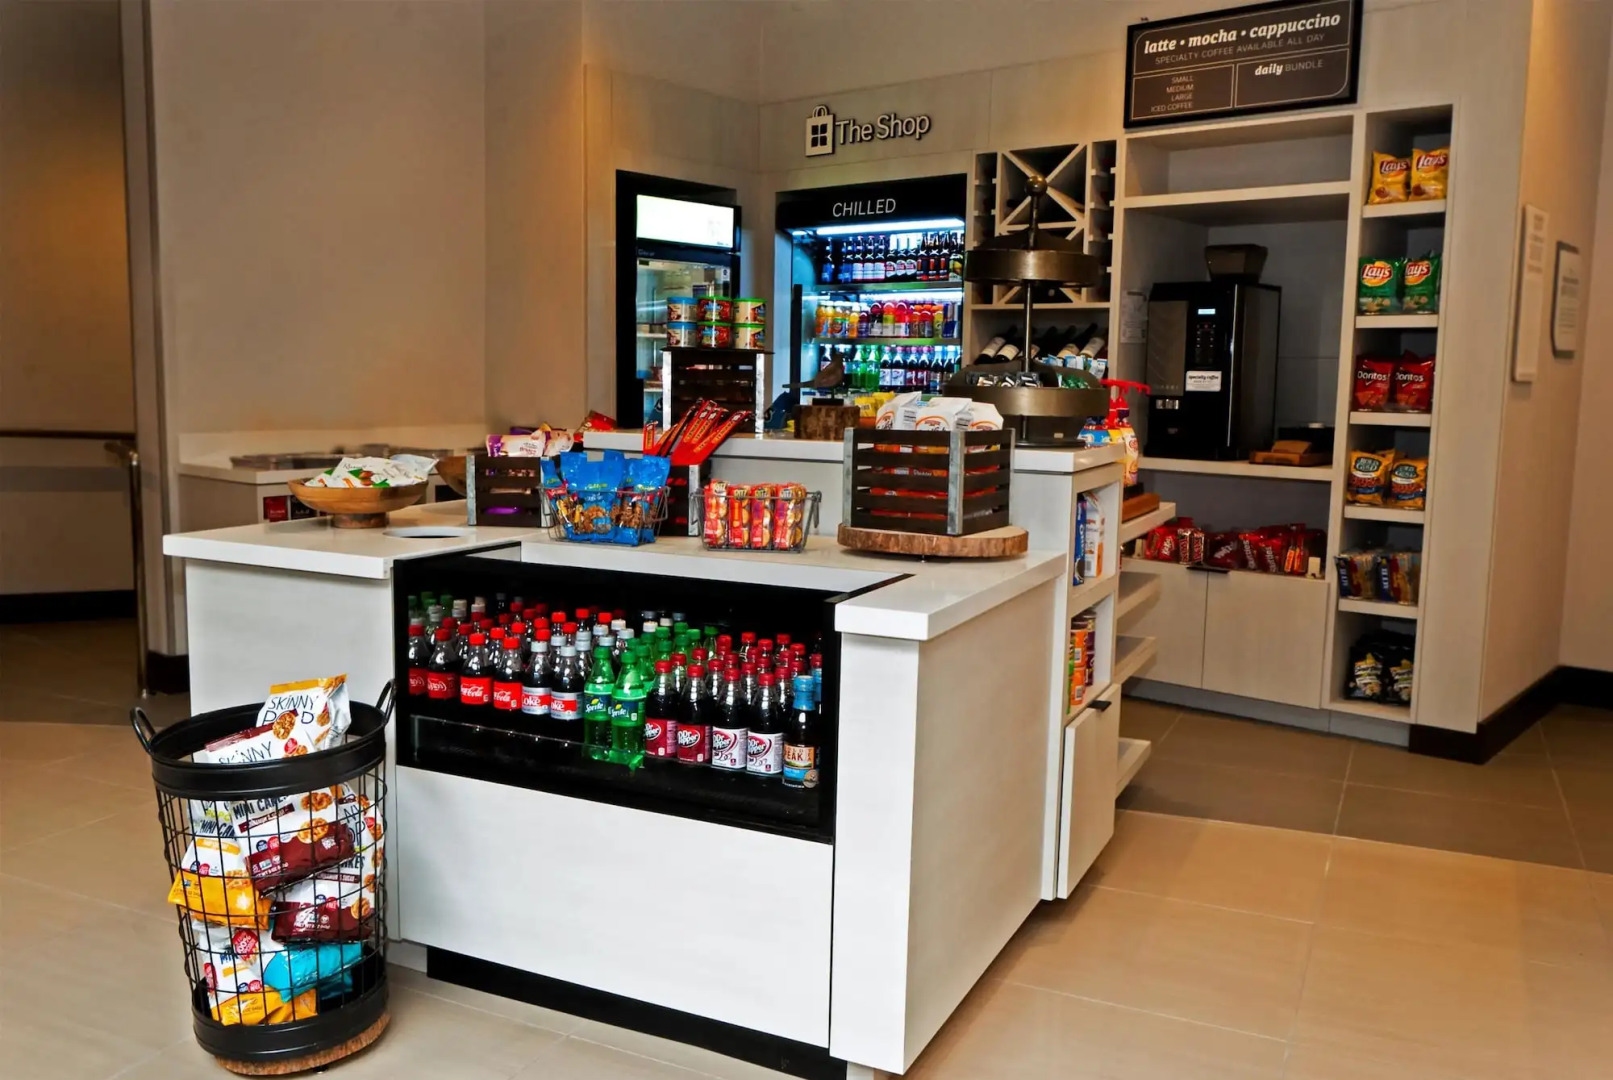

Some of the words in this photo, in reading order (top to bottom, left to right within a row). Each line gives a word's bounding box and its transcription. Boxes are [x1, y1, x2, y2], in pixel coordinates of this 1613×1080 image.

[1144, 38, 1177, 54] latte
[1188, 28, 1237, 47] mocha
[1249, 13, 1341, 40] cappuccino
[1154, 52, 1199, 65] SPECIALTY
[1201, 46, 1234, 58] COFFEE
[1236, 39, 1284, 54] AVAILABLE
[1286, 36, 1303, 45] ALL
[1306, 33, 1325, 43] DAY
[1254, 63, 1283, 76] daily
[1285, 59, 1324, 72] BUNDLE
[1171, 75, 1194, 83] SMALL
[1166, 84, 1194, 93] MEDIUM
[1171, 93, 1193, 101] LARGE
[1167, 102, 1193, 111] COFFEE
[835, 119, 874, 144] The
[876, 113, 930, 141] Shop
[832, 198, 896, 217] CHILLED
[1362, 264, 1391, 279] Lay's
[1357, 370, 1388, 381] Doritos
[268, 694, 320, 710] SKINNY
[586, 702, 604, 713] Sprite
[232, 803, 255, 820] MINI
